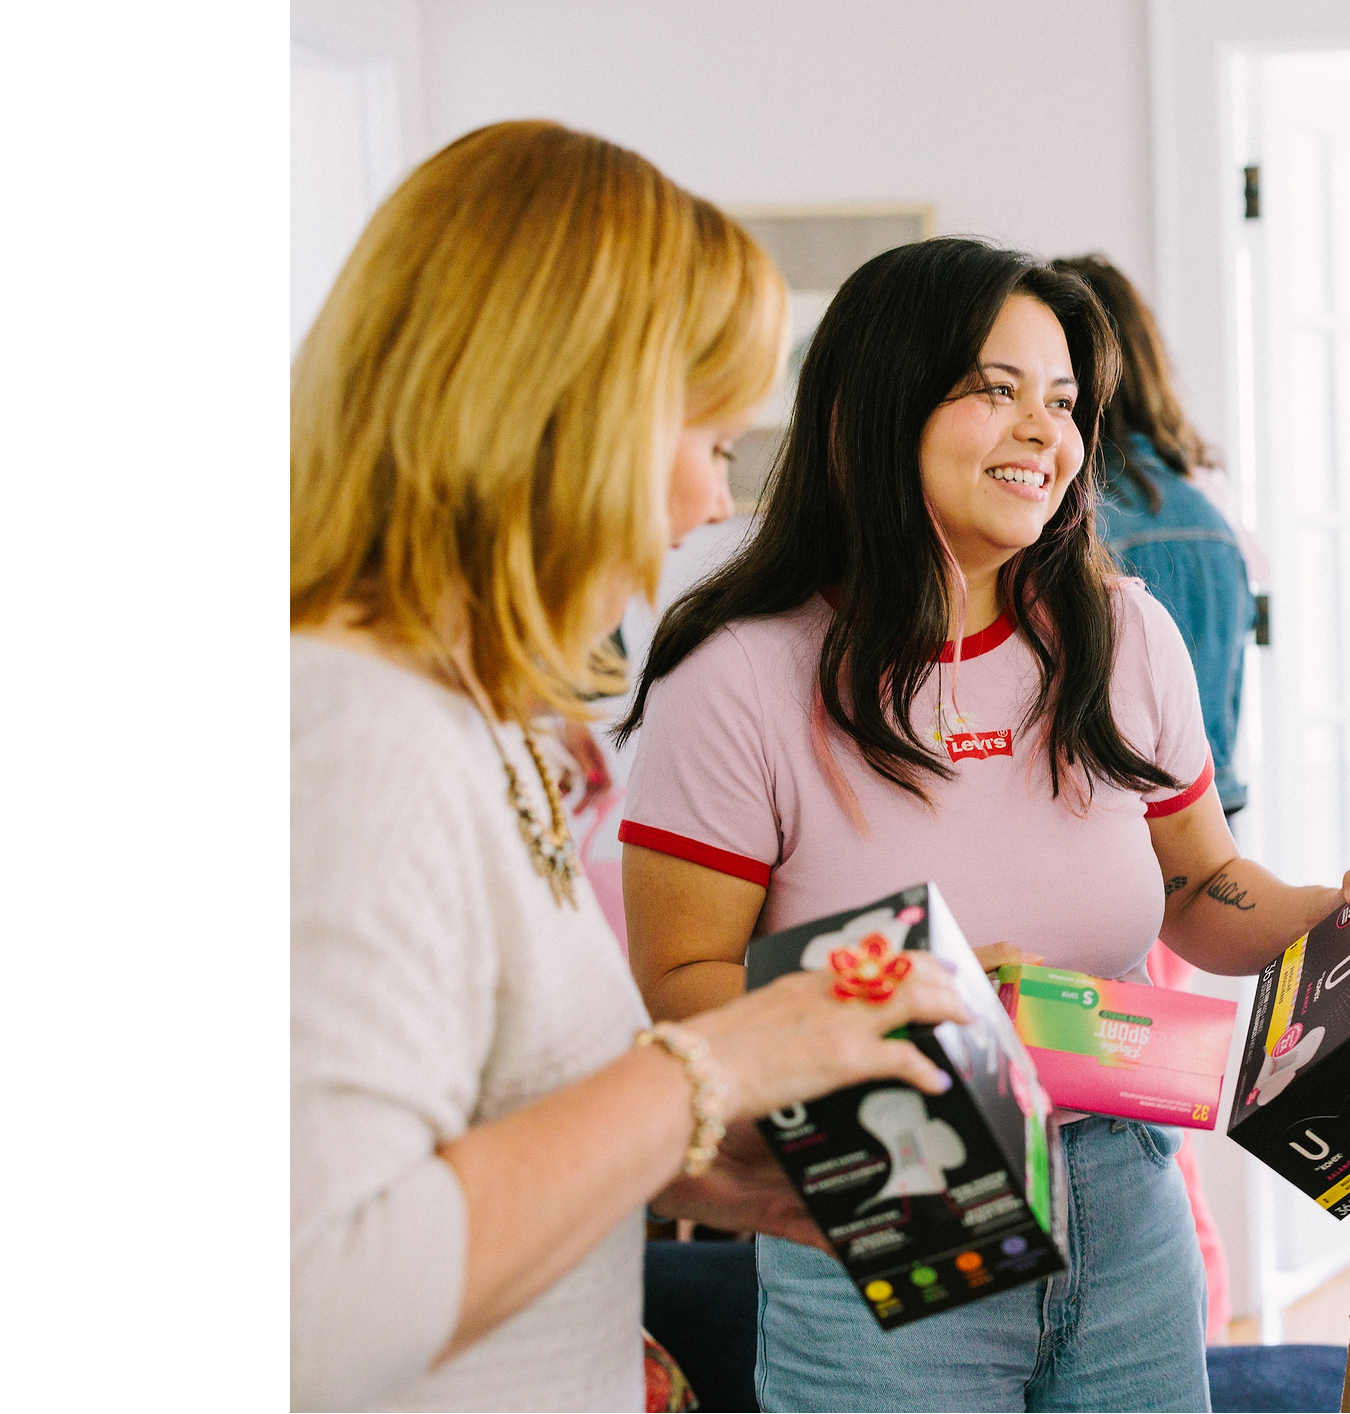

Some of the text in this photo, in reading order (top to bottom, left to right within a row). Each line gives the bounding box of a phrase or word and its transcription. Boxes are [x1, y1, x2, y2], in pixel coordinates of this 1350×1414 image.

[1262, 958, 1277, 983] 36
[1081, 989, 1094, 1005] S
[1097, 1019, 1150, 1045] SPORT
[1191, 1103, 1210, 1121] 32
[1287, 1128, 1335, 1165] U
